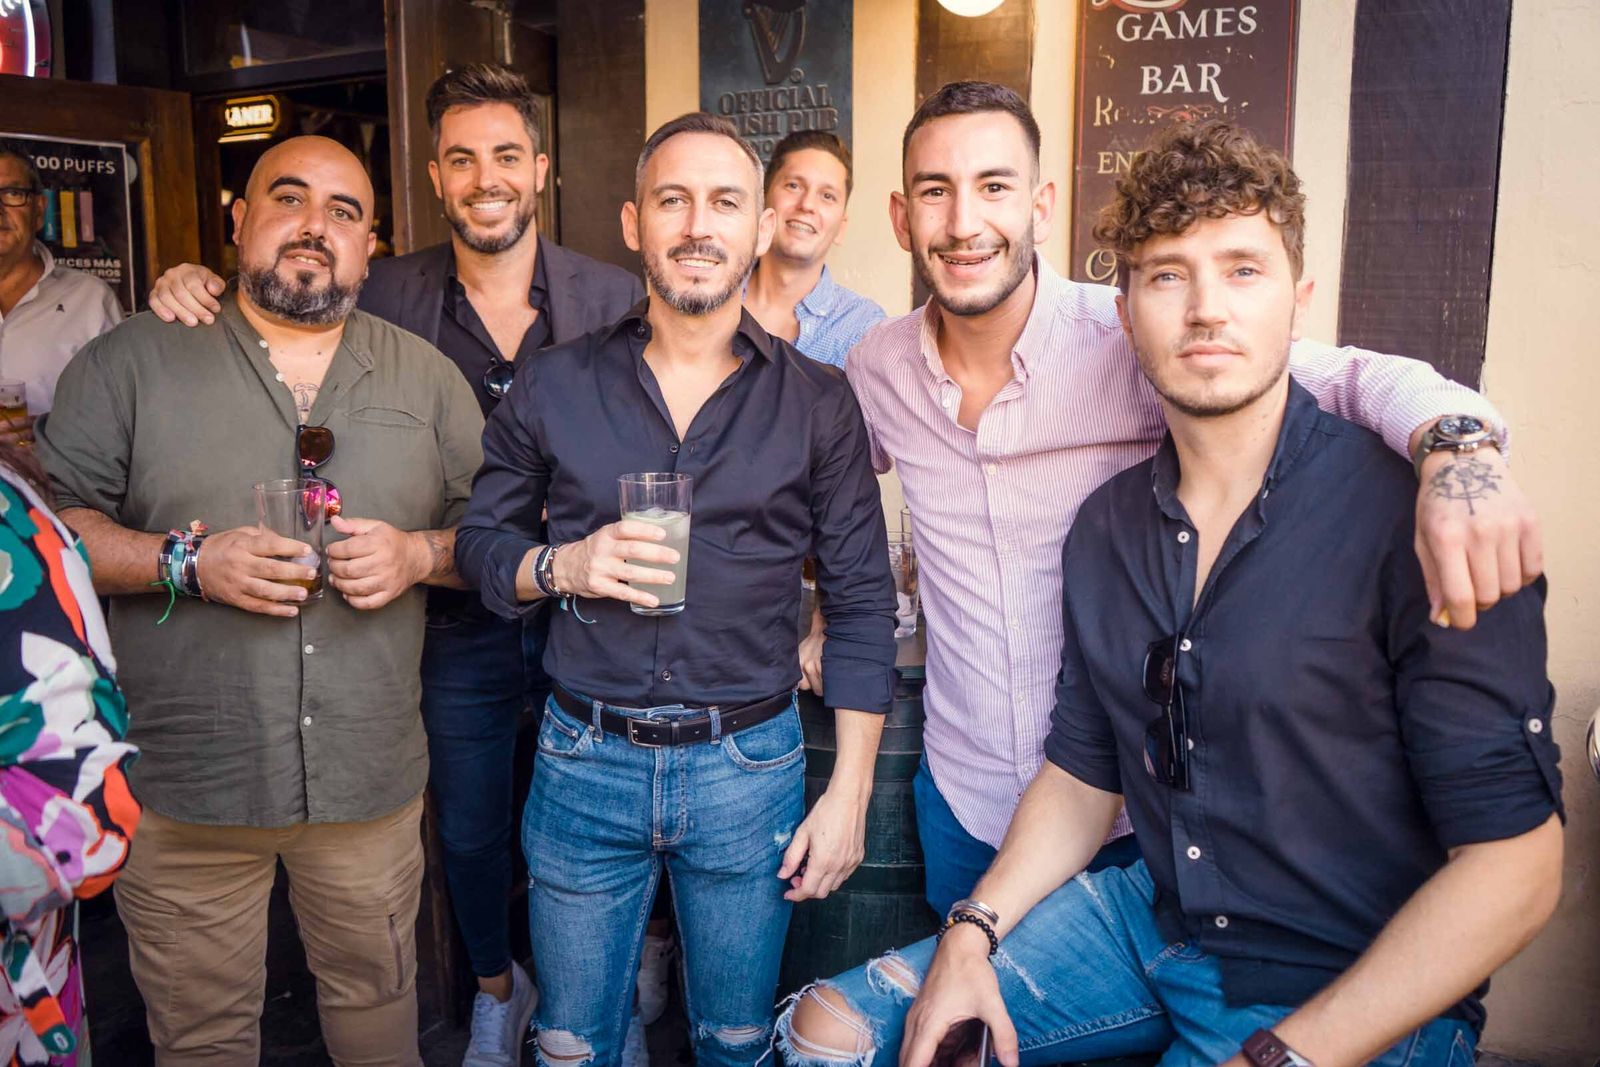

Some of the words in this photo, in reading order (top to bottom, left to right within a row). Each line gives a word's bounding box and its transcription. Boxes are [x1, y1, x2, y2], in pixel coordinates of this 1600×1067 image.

[1116, 6, 1258, 42] GAMES
[1140, 62, 1230, 103] BAR
[719, 84, 833, 115] OFFICIAL
[732, 111, 782, 136] ISH
[787, 108, 839, 132] PUB
[31, 155, 60, 170] 00
[64, 158, 116, 175] PUFFS
[1097, 151, 1138, 174] EN
